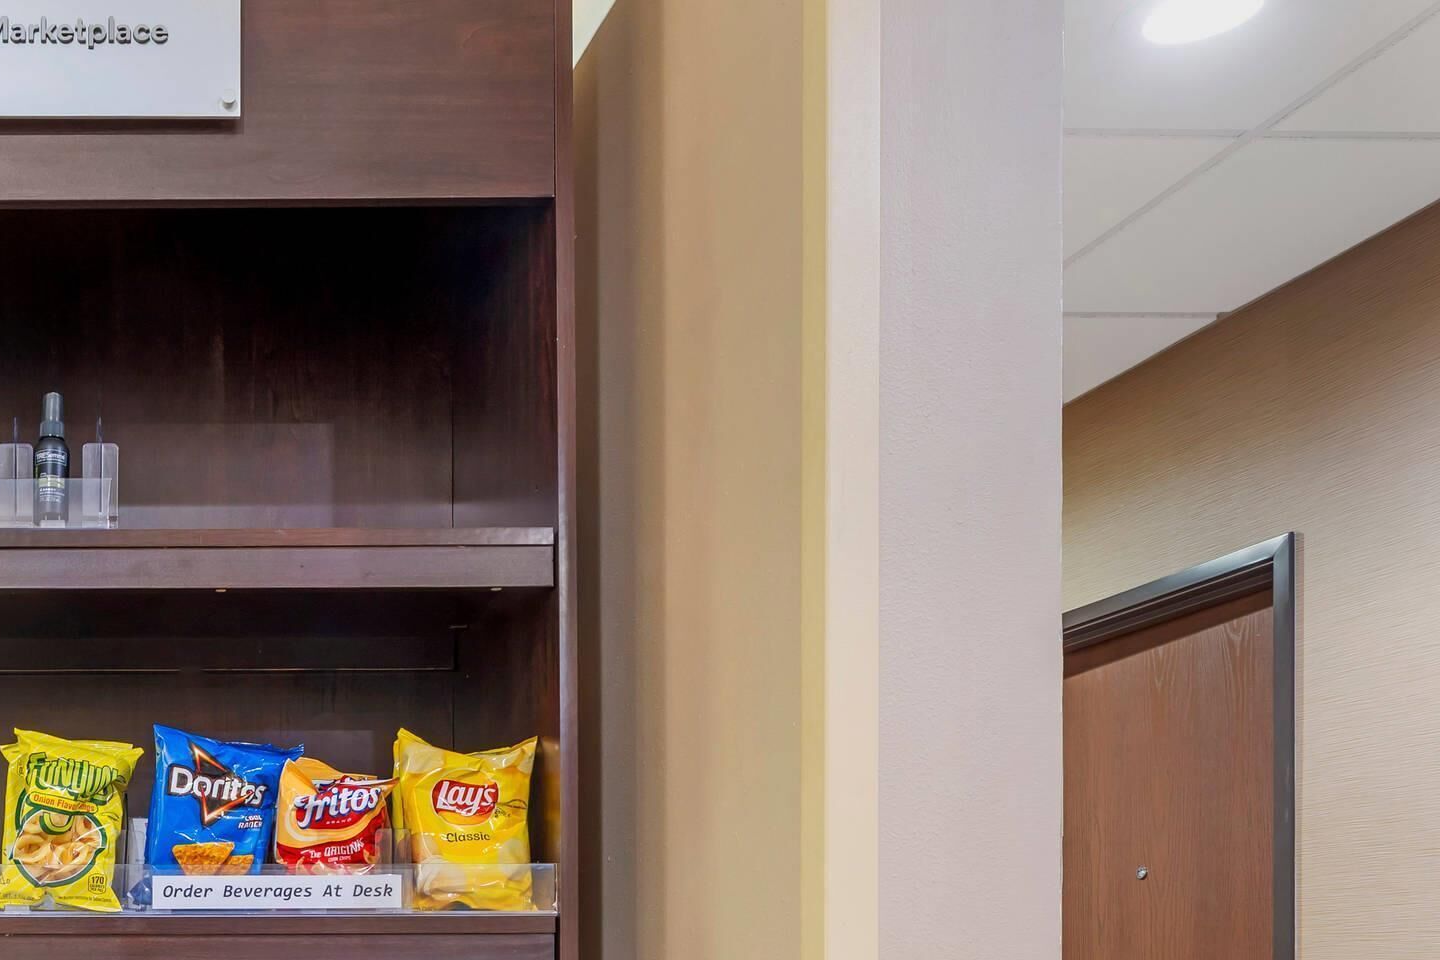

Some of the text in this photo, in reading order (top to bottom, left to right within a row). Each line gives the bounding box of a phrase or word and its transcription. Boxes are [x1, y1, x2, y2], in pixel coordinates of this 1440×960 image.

[26, 752, 121, 806] FUNYUN
[170, 766, 266, 806] Doritos
[33, 794, 56, 807] Onion
[294, 787, 381, 828] Fritos
[436, 780, 496, 816] Lay's
[446, 831, 491, 843] Classic
[91, 875, 104, 884] 170
[163, 883, 393, 901] Order Beverages At Desk
